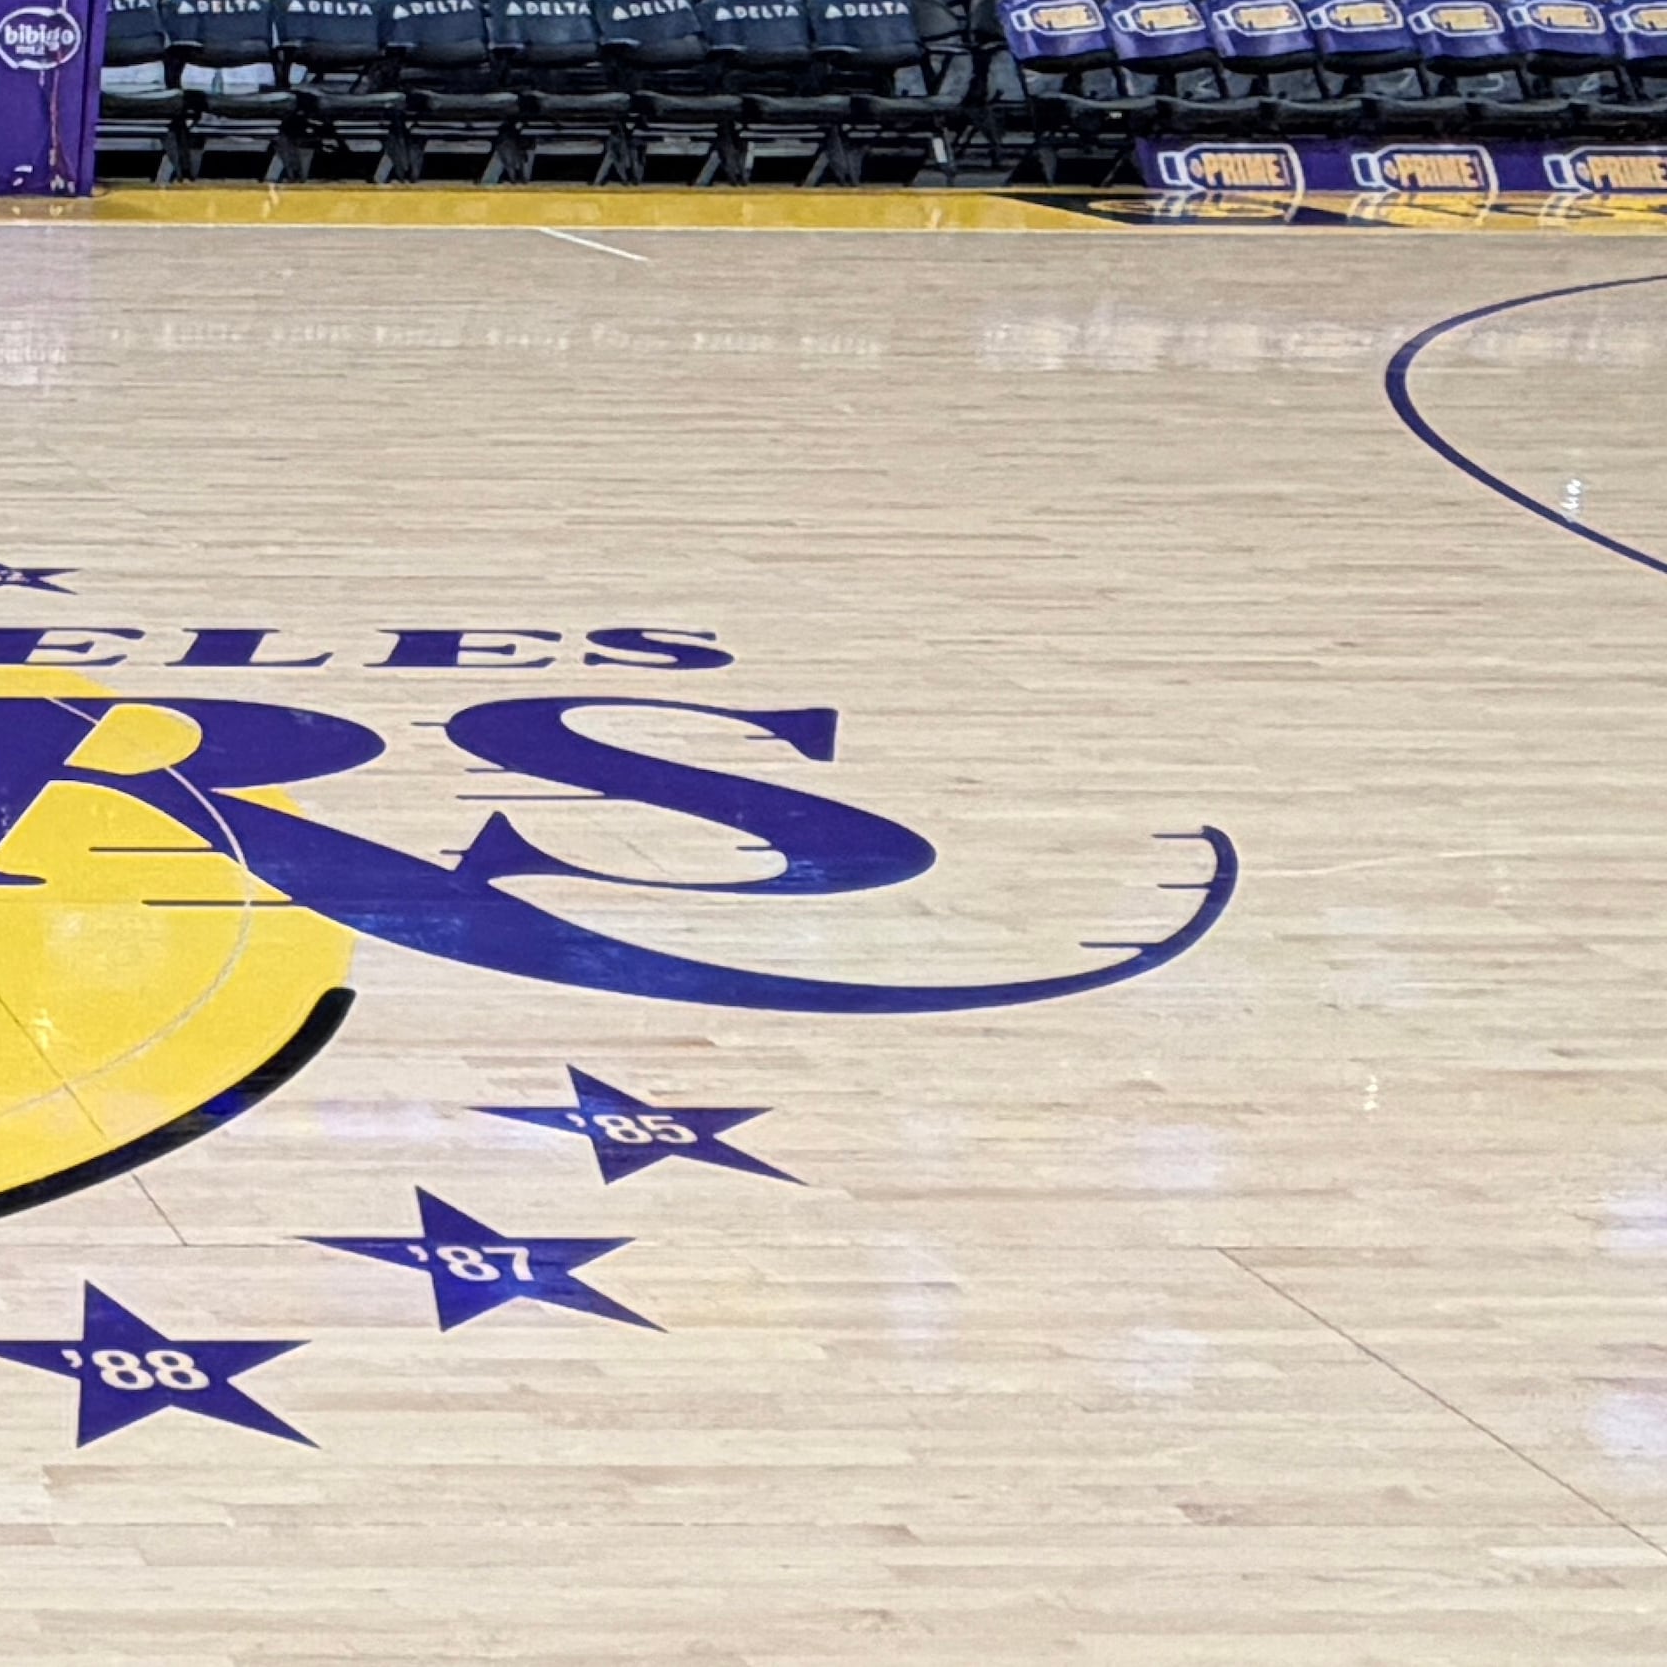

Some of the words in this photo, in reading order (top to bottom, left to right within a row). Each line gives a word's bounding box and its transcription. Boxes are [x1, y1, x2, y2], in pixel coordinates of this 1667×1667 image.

[525, 0, 592, 17] DELTA
[734, 3, 799, 20] DELTA
[843, 0, 909, 18] DELTA
[4, 24, 76, 52] bibigo
[1201, 152, 1281, 187] PRIME
[1394, 153, 1481, 188] PRIME
[566, 1112, 698, 1145] '85
[405, 1244, 535, 1283] '87
[60, 1347, 211, 1391] '88
